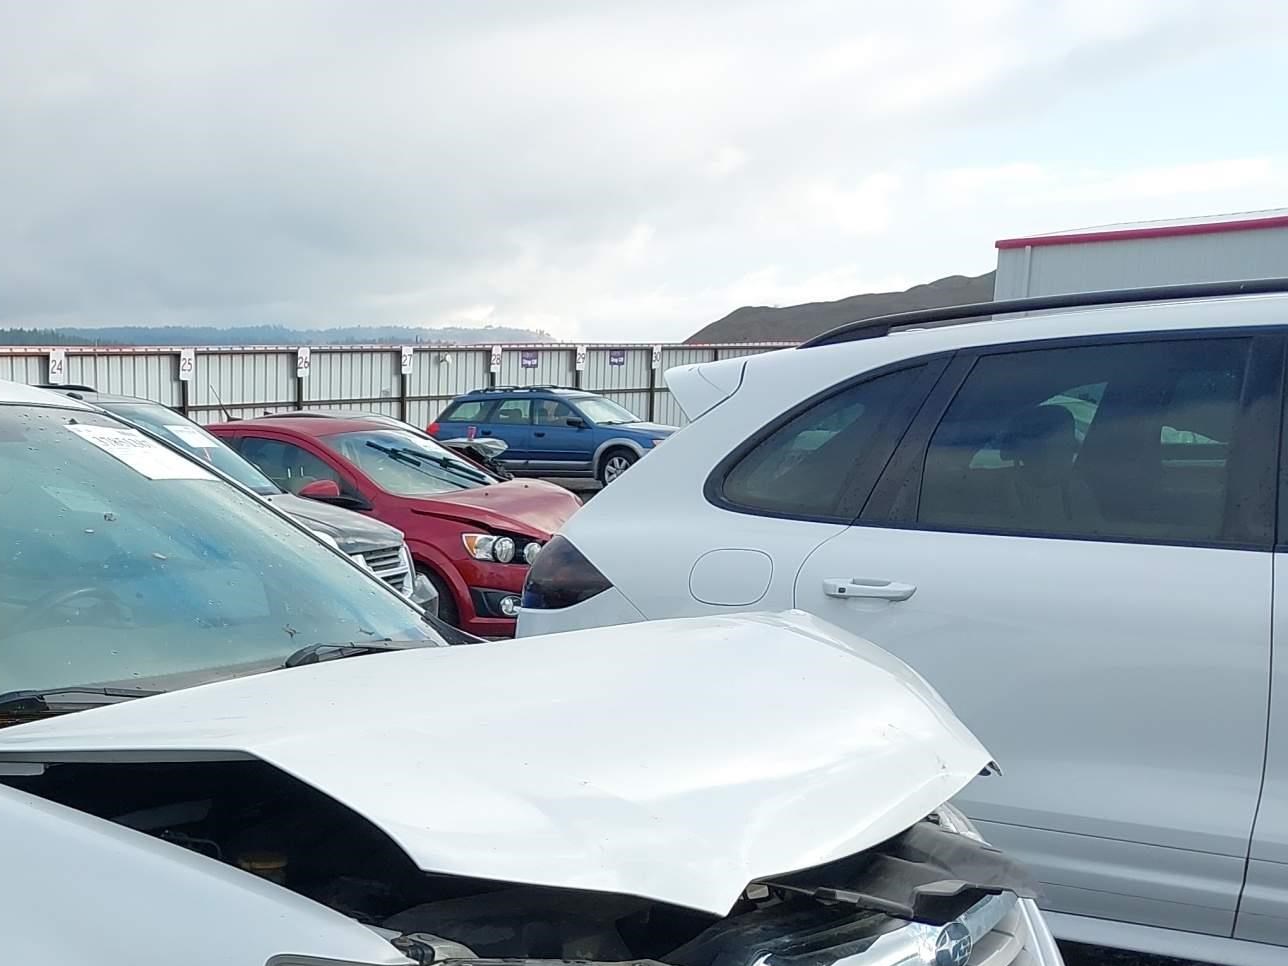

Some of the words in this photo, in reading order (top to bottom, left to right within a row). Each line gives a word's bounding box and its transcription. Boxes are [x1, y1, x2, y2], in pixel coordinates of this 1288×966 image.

[50, 359, 63, 374] 24
[181, 357, 193, 372] 25
[298, 356, 310, 369] 26
[402, 354, 412, 366] 27
